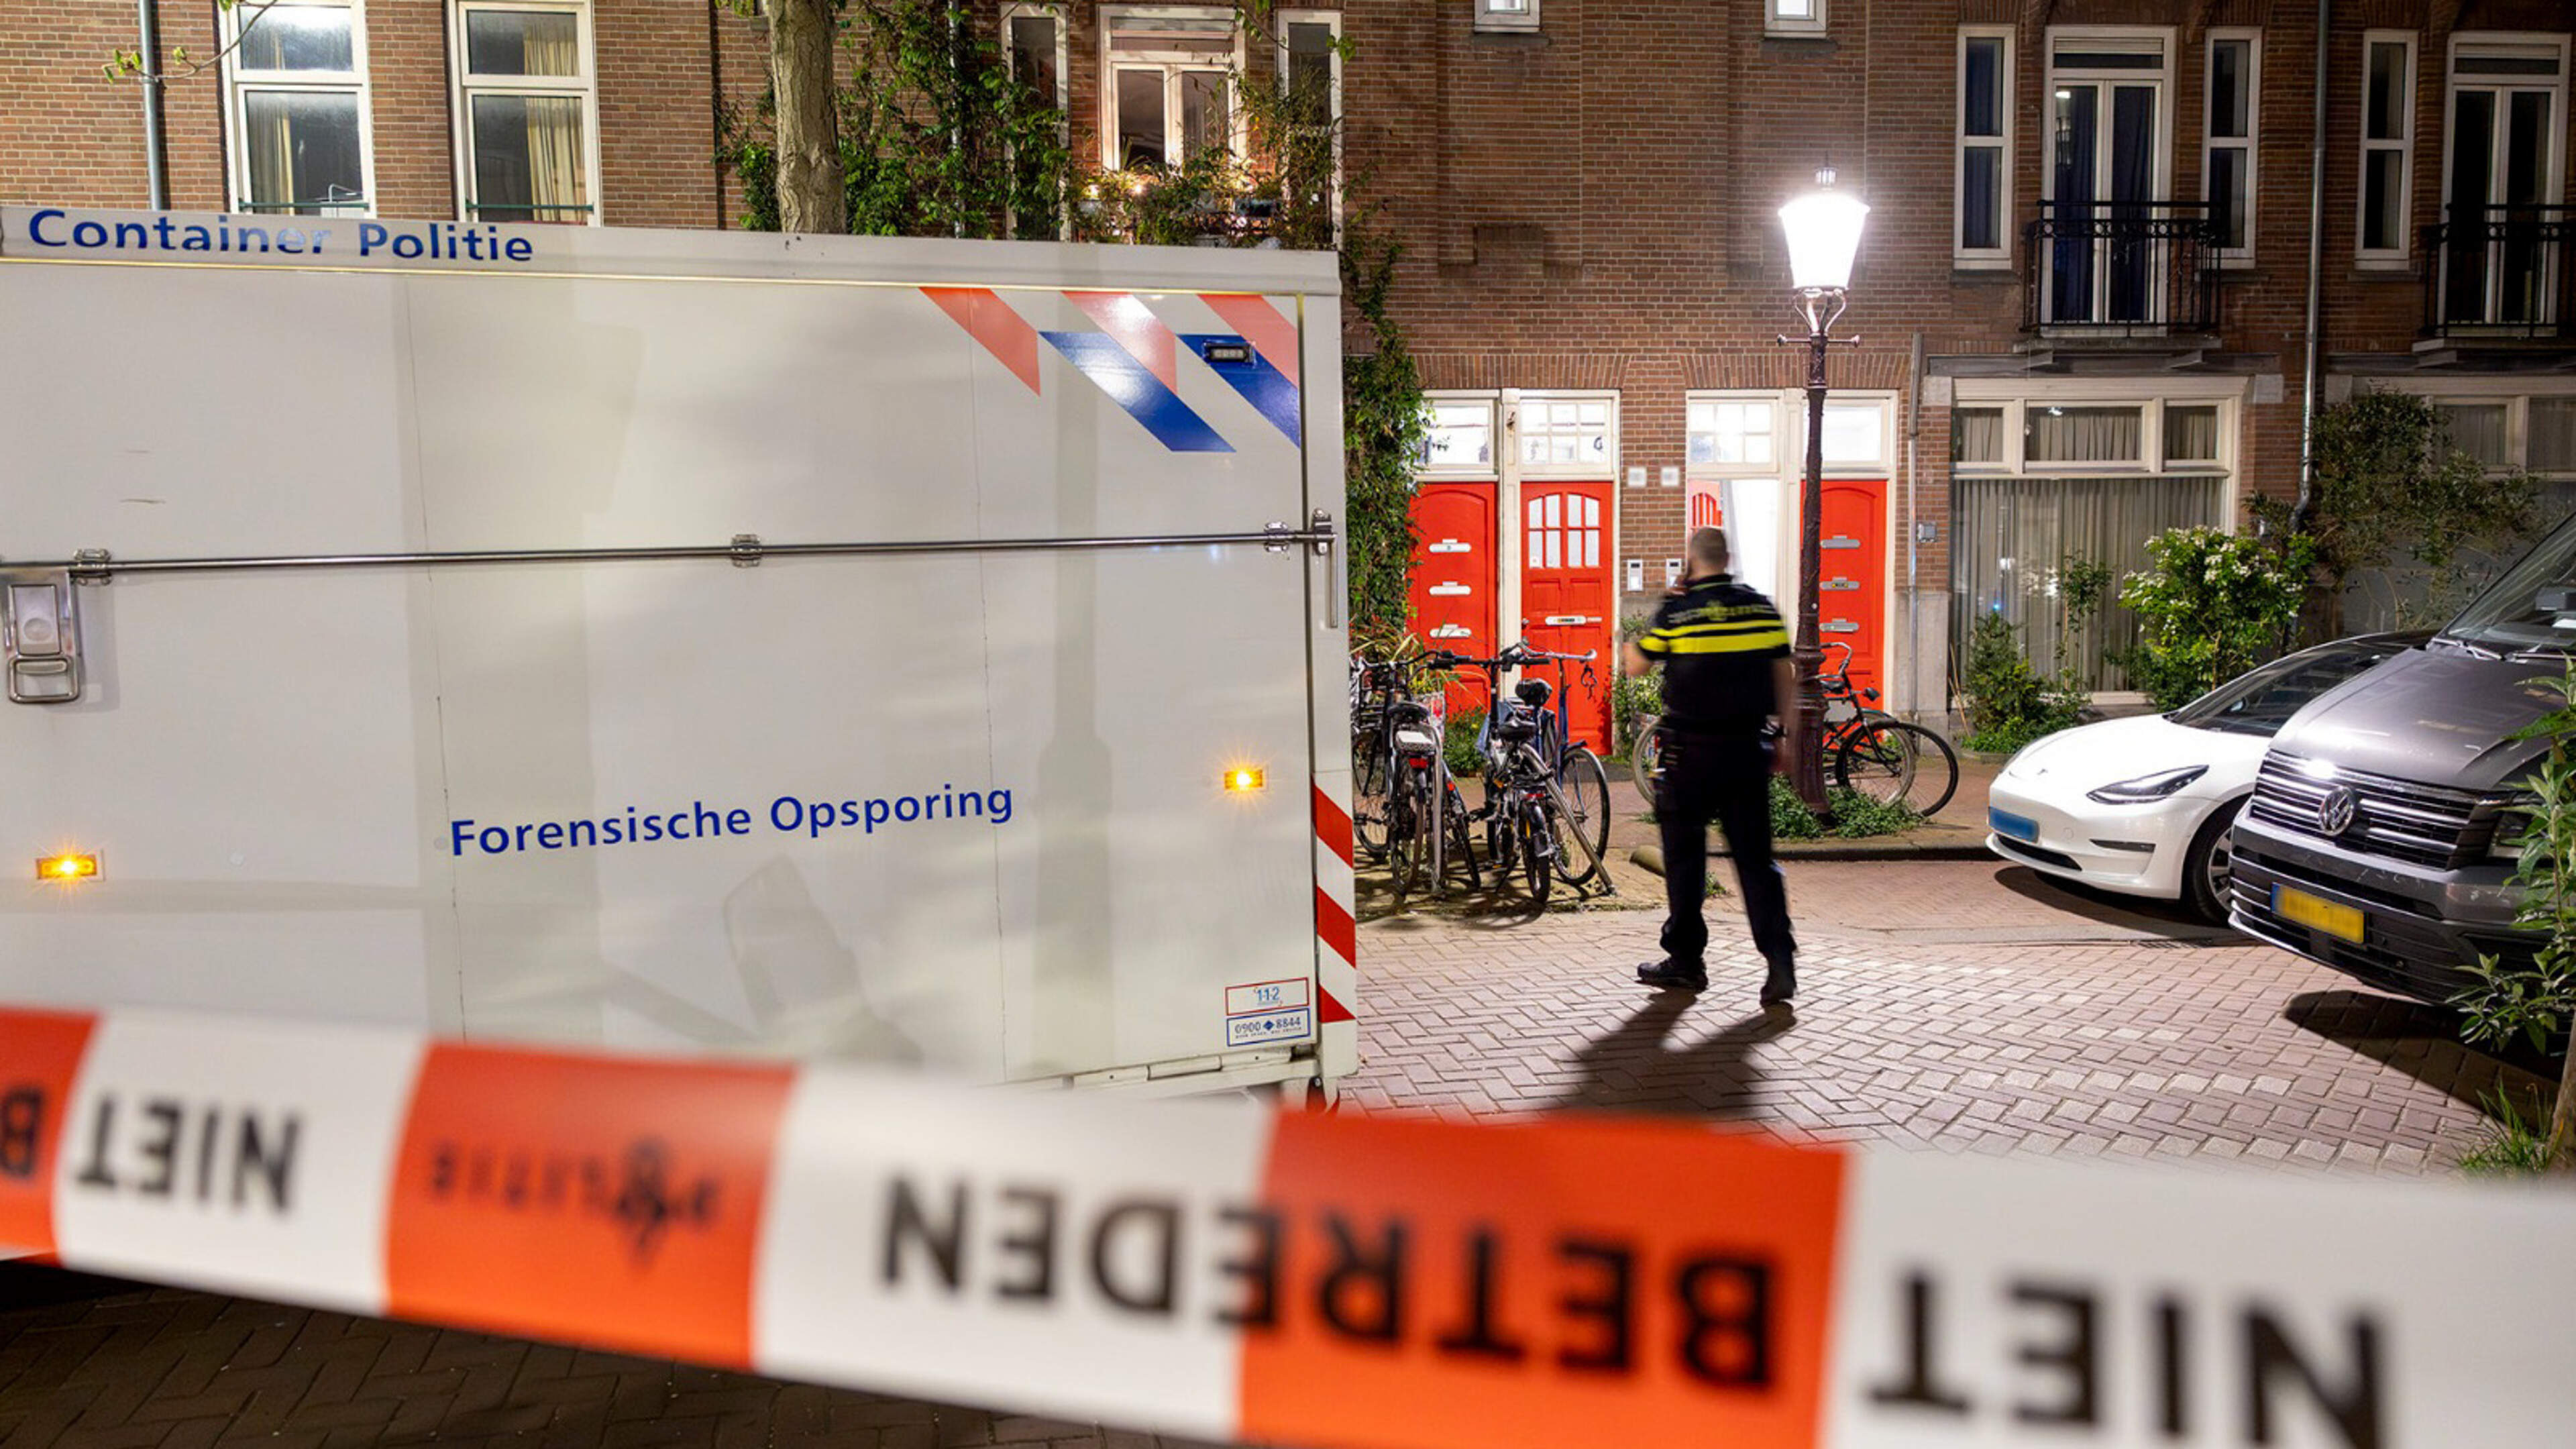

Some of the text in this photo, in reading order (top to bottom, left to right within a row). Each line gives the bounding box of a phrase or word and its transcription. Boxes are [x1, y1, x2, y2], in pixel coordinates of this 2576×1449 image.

[29, 209, 533, 262] Container Politie
[451, 784, 1012, 856] Forensische Opsporing
[1235, 1021, 1261, 1034] 0900
[76, 1089, 301, 1217] NIET
[875, 1175, 1780, 1394] BETREDEN
[1866, 1267, 2390, 1449] NIET
